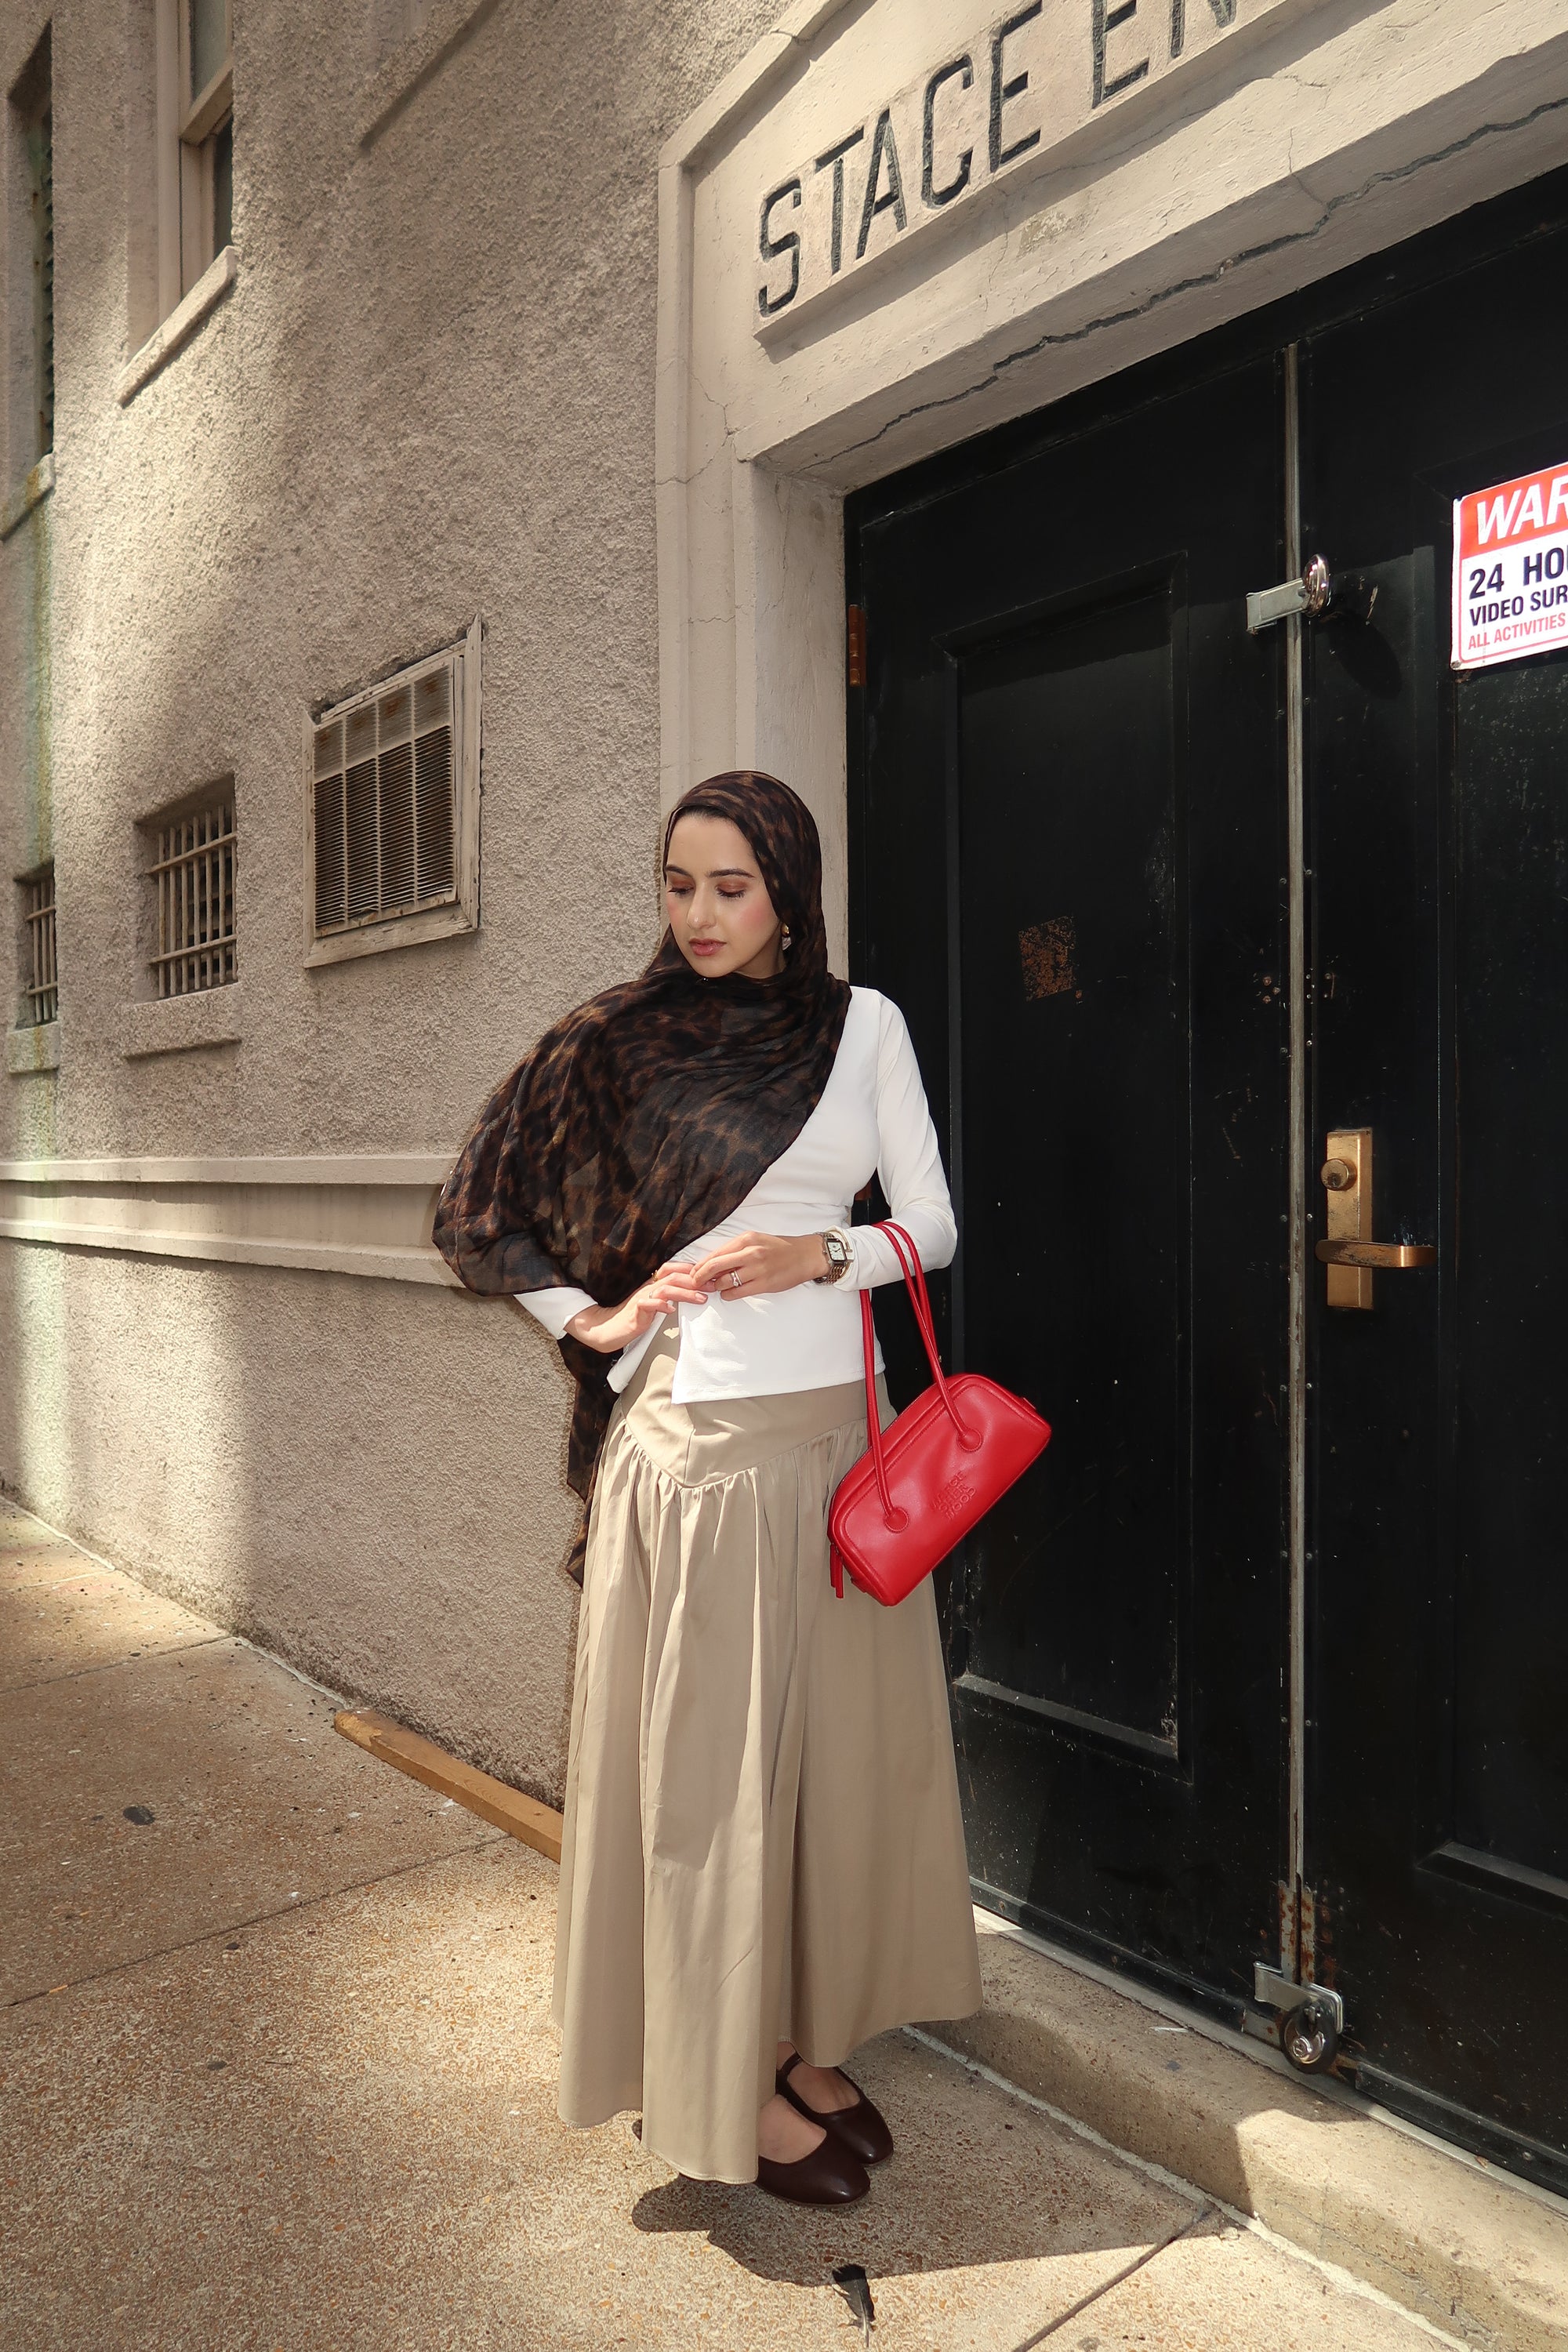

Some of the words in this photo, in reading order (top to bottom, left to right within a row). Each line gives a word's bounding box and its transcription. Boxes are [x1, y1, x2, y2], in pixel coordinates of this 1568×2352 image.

[1476, 474, 1568, 546] WAR
[1469, 563, 1504, 600] 24
[1523, 545, 1568, 586] HO
[1469, 596, 1524, 626] VIDEO
[1530, 584, 1568, 612] SUR
[1468, 632, 1490, 650] ALL
[1494, 612, 1566, 644] ACTIVITIES
